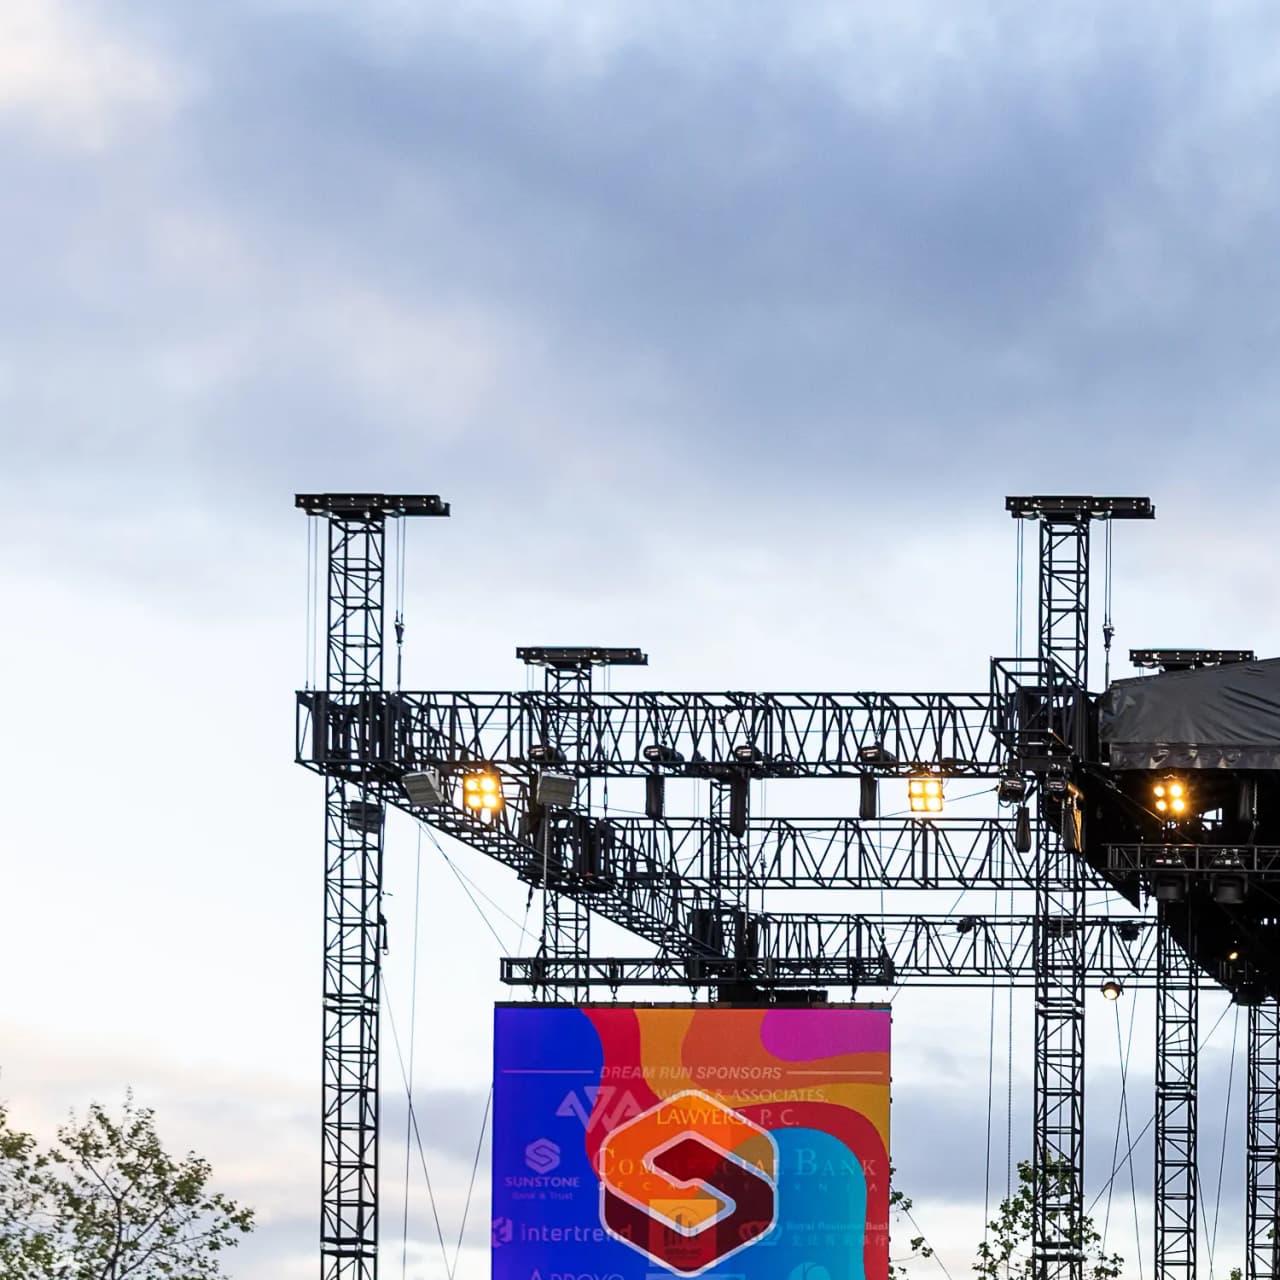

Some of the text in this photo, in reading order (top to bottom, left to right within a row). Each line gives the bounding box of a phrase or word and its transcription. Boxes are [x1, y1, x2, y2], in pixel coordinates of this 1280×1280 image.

[600, 1066, 782, 1080] DREAM RUN SPONSORS
[504, 1176, 580, 1188] SUNSTONE
